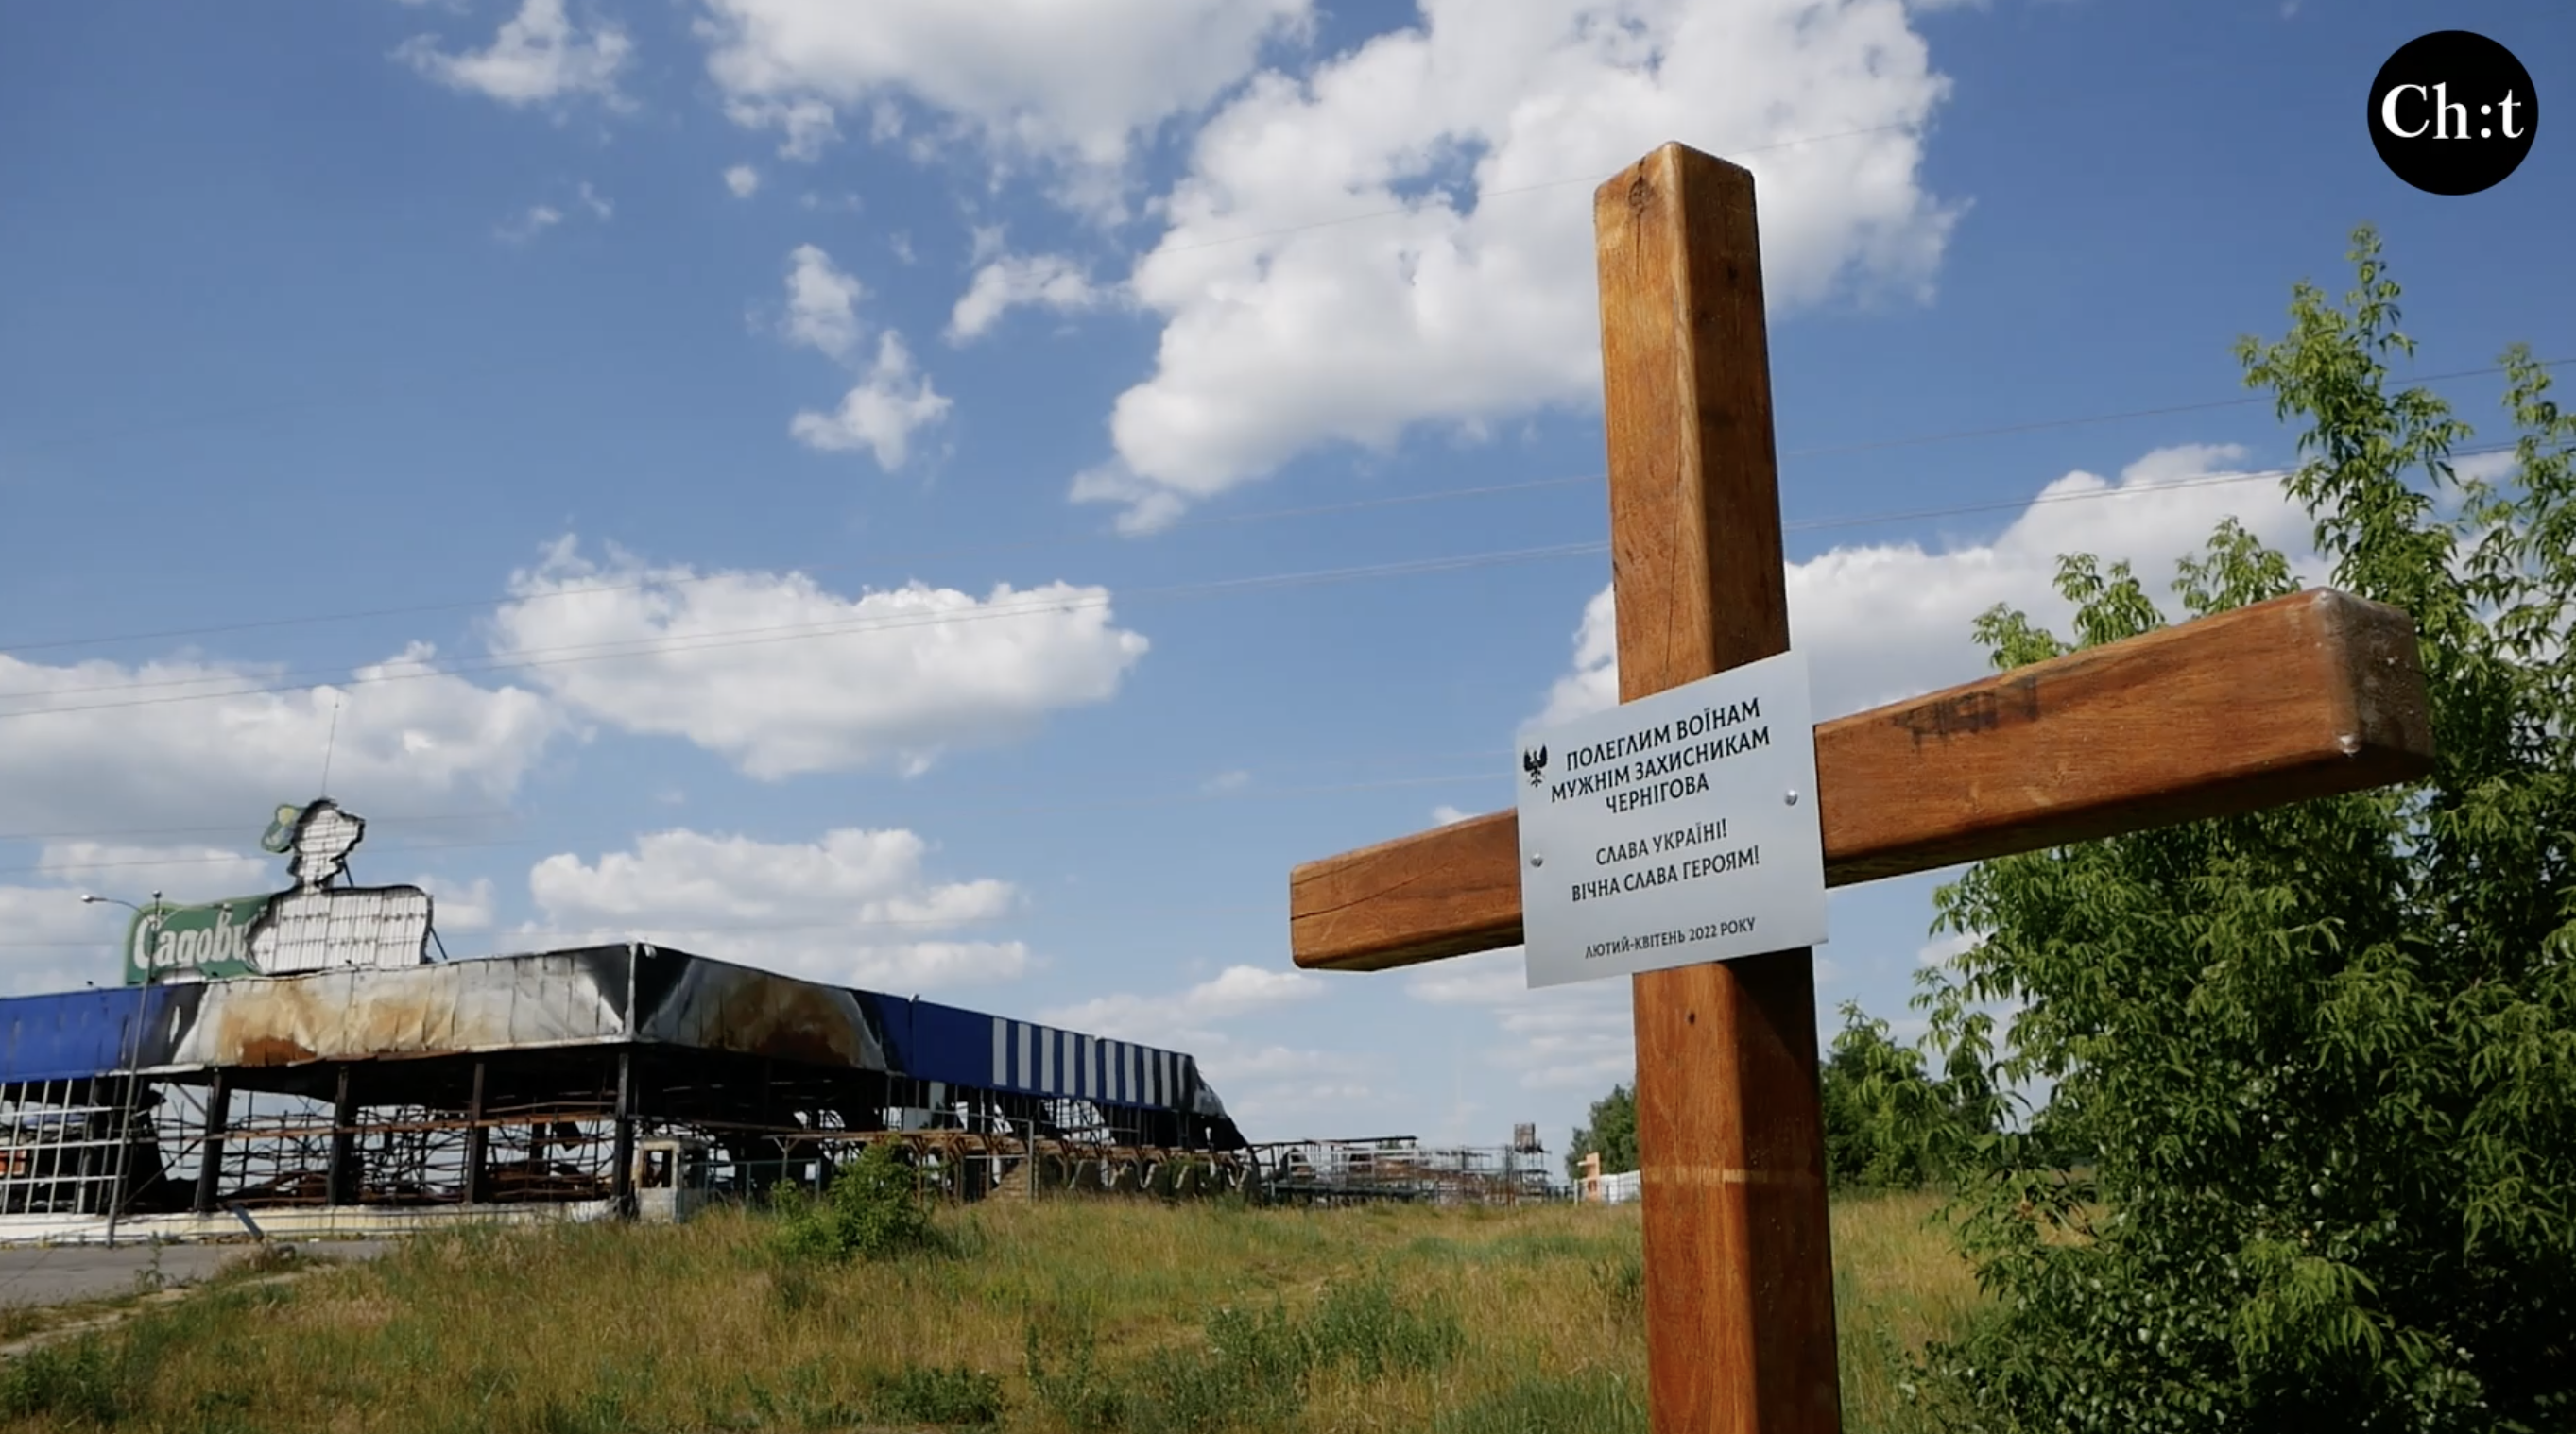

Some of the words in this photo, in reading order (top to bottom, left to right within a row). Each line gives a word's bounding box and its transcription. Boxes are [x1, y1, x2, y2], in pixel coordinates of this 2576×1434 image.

[1566, 724, 1672, 772] ПОЛЕГЛИМ
[1676, 697, 1760, 741] ВОЇНАМ
[1551, 765, 1631, 803] МУЖНІМ
[1635, 726, 1771, 781] ЗАХИСНИКАМ
[1606, 772, 1710, 814] ЧЕРНІГОВА
[1595, 839, 1650, 866] СЛАВА
[1652, 818, 1727, 853] УКРАЇНІ!
[1571, 877, 1621, 902] ВІЧНА
[1623, 864, 1679, 892] СЛАВА
[1682, 845, 1760, 880] ГЕРОЯМ!
[1585, 930, 1687, 960] ЛЮТИЙ-КВІТЕНЬ
[1688, 923, 1718, 943] 2022
[1719, 917, 1757, 937] РОКУ
